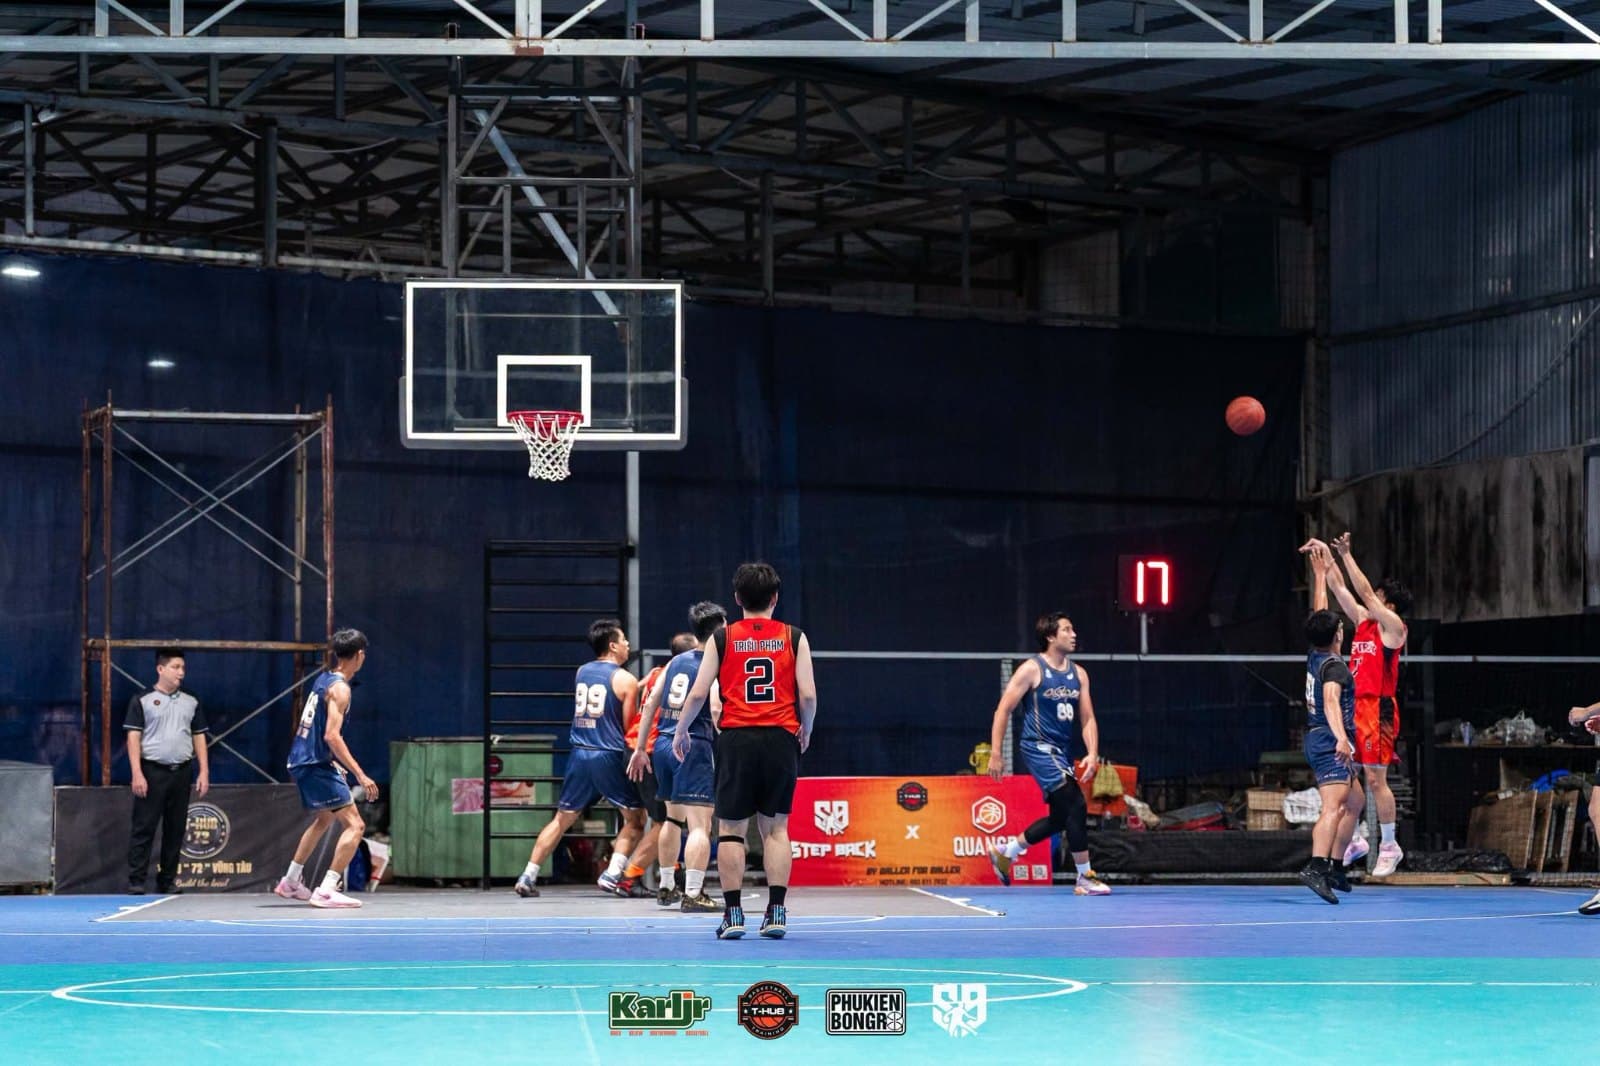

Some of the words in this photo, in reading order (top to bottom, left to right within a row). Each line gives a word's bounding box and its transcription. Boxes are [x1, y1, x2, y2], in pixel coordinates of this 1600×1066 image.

[1136, 560, 1169, 605] 17
[668, 673, 690, 709] 9
[744, 657, 776, 704] 2
[575, 683, 608, 718] 99
[791, 840, 832, 859] STEP
[834, 839, 876, 858] BACK
